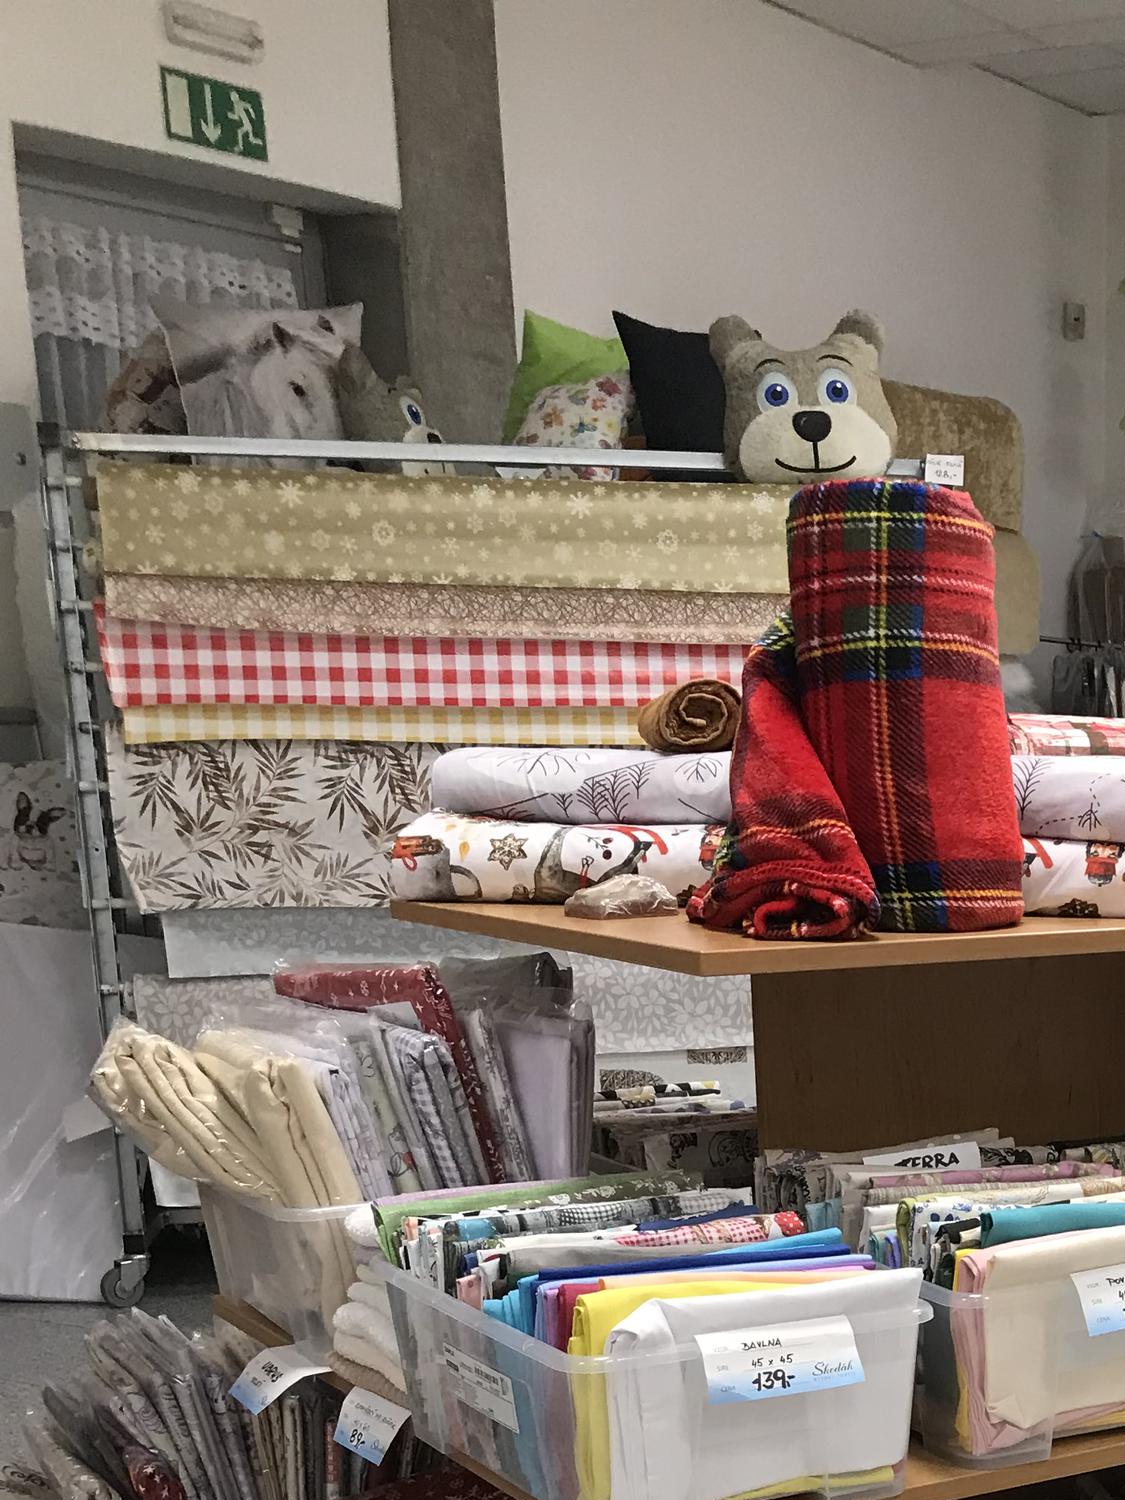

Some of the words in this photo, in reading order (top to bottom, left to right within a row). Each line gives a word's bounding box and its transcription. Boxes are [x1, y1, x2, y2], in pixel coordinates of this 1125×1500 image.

[741, 1338, 783, 1351] BAVLNA
[752, 1358, 764, 1368] 45
[780, 1354, 794, 1364] 45
